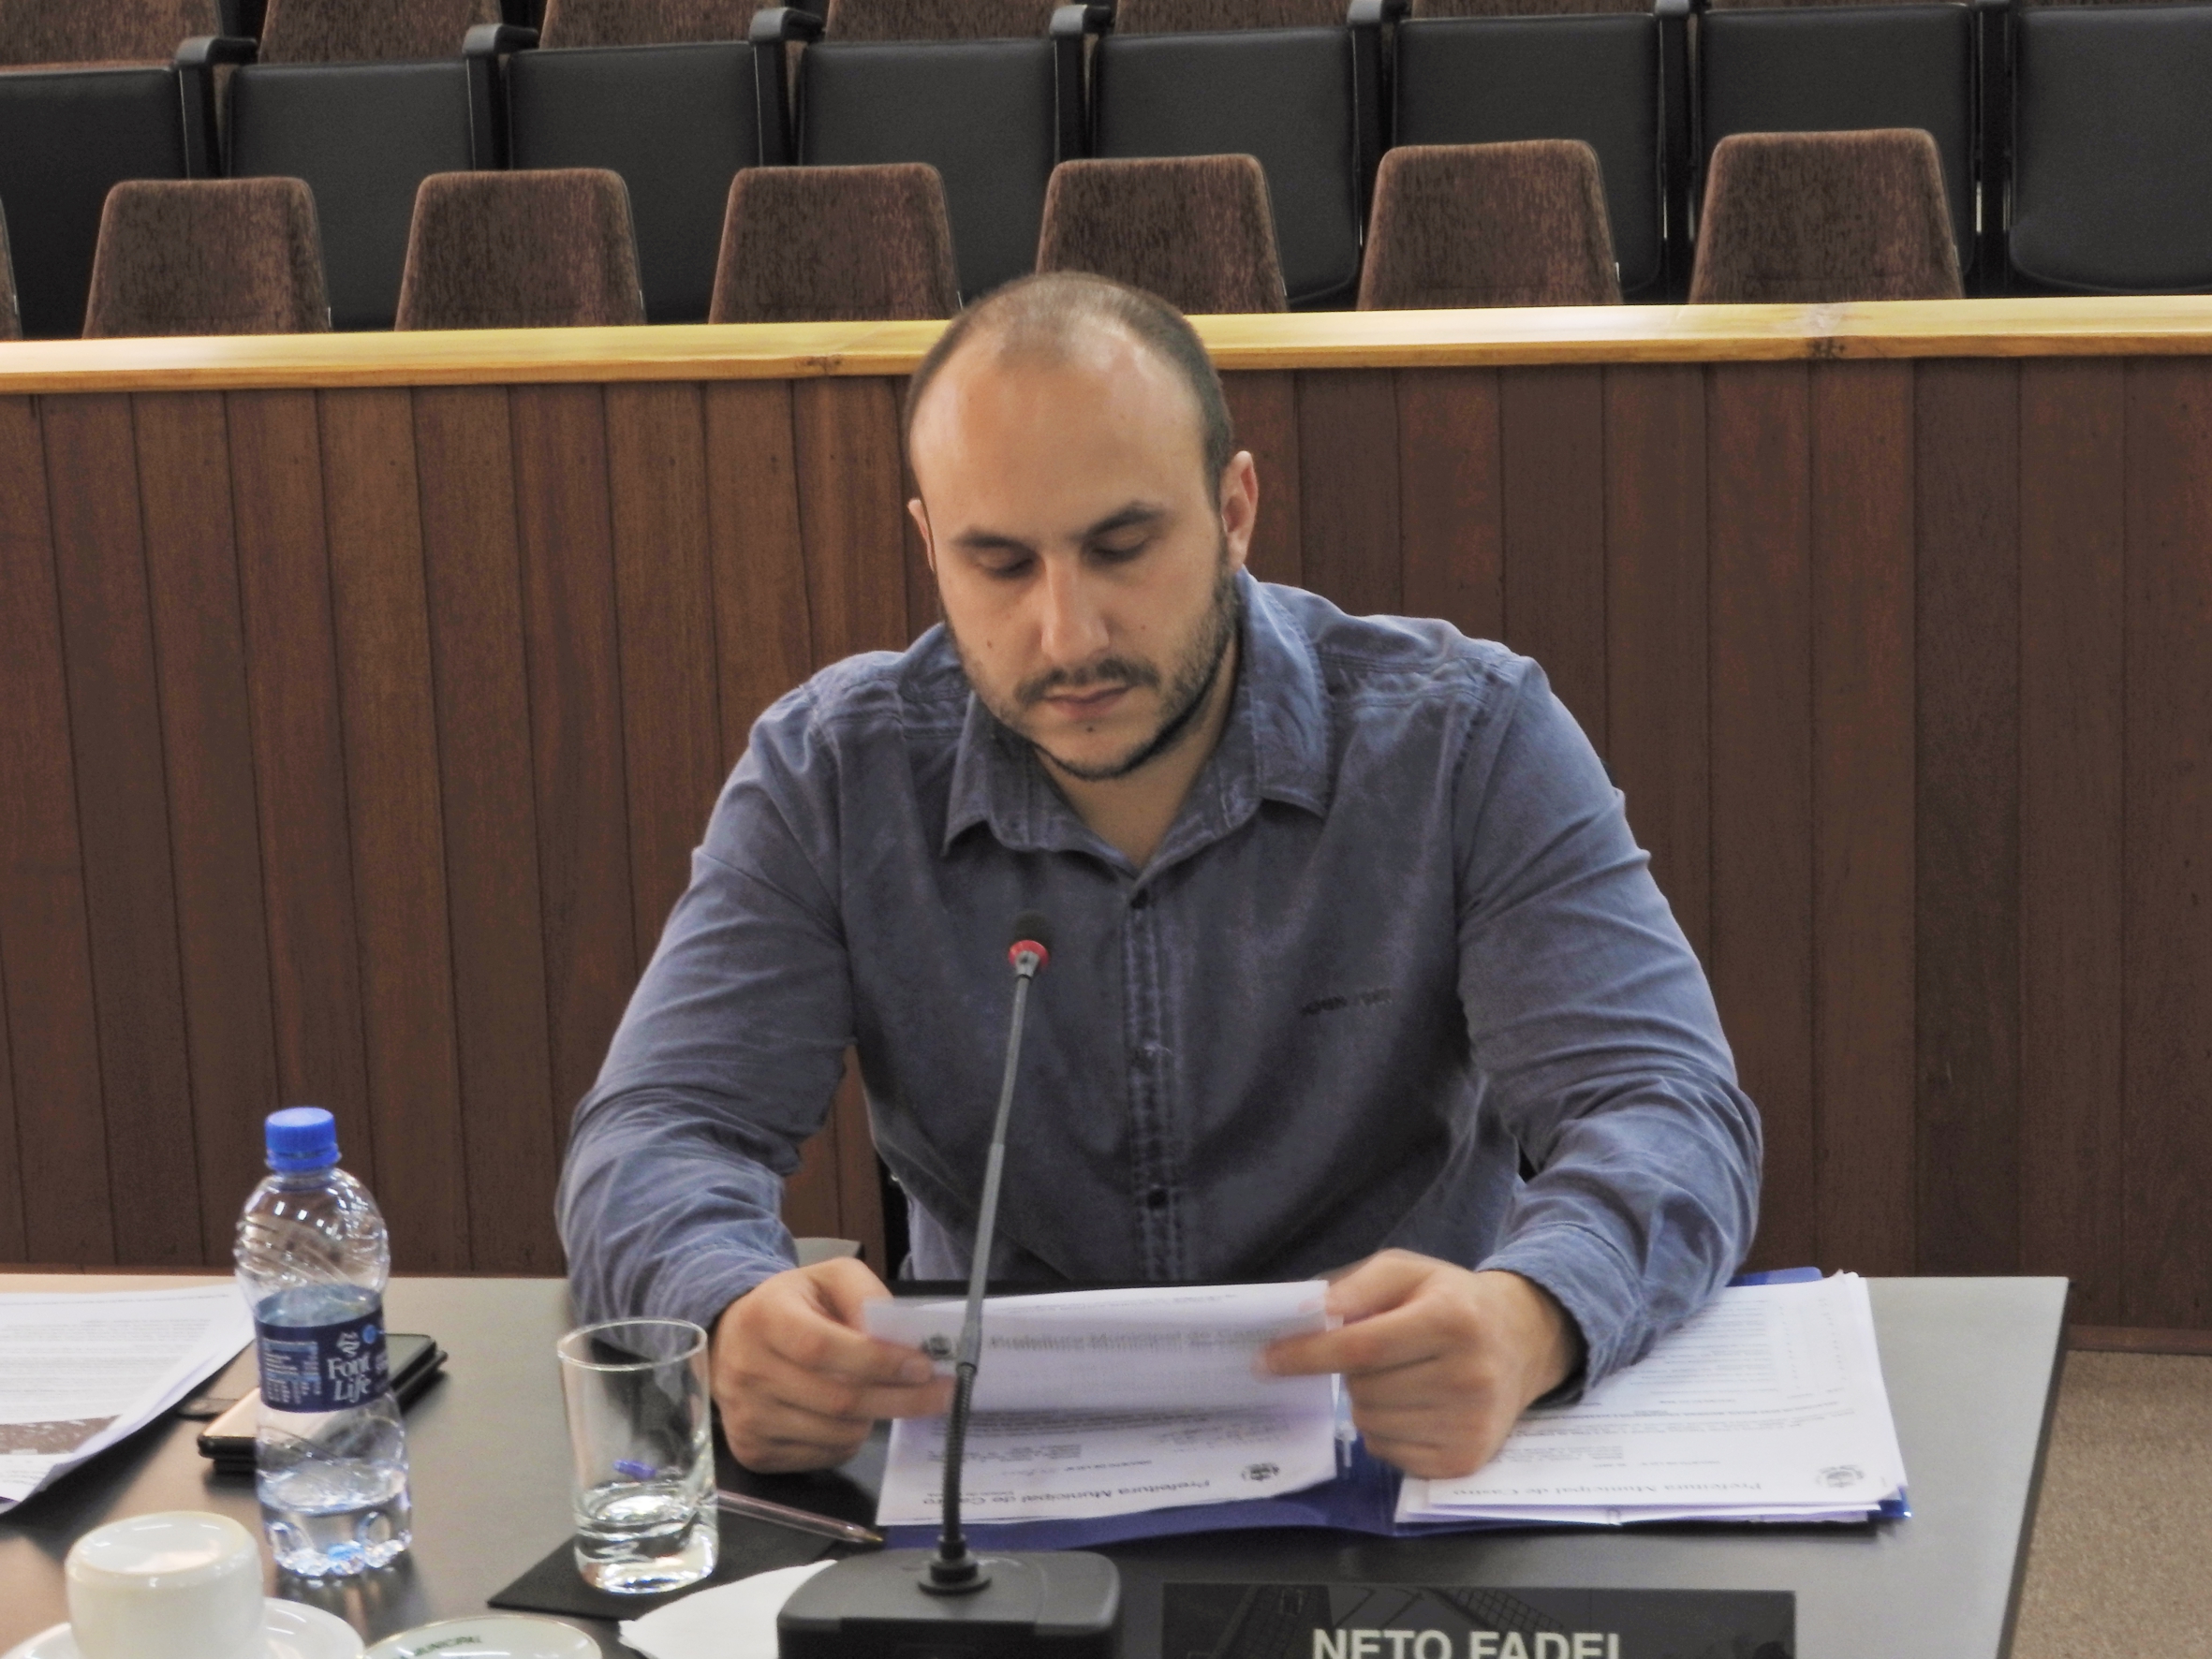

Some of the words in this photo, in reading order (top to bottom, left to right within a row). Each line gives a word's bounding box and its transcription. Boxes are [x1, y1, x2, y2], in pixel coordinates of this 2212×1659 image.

[333, 1373, 372, 1403] Life
[1118, 1478, 1210, 1495] Prefeitura
[1526, 1487, 1549, 1495] de
[1555, 1484, 1657, 1494] Municipal
[1664, 1481, 1762, 1491] Prefeitura
[922, 1497, 986, 1505] Caro
[1022, 1489, 1112, 1503] Municipal
[1312, 1628, 1452, 1659] NETO
